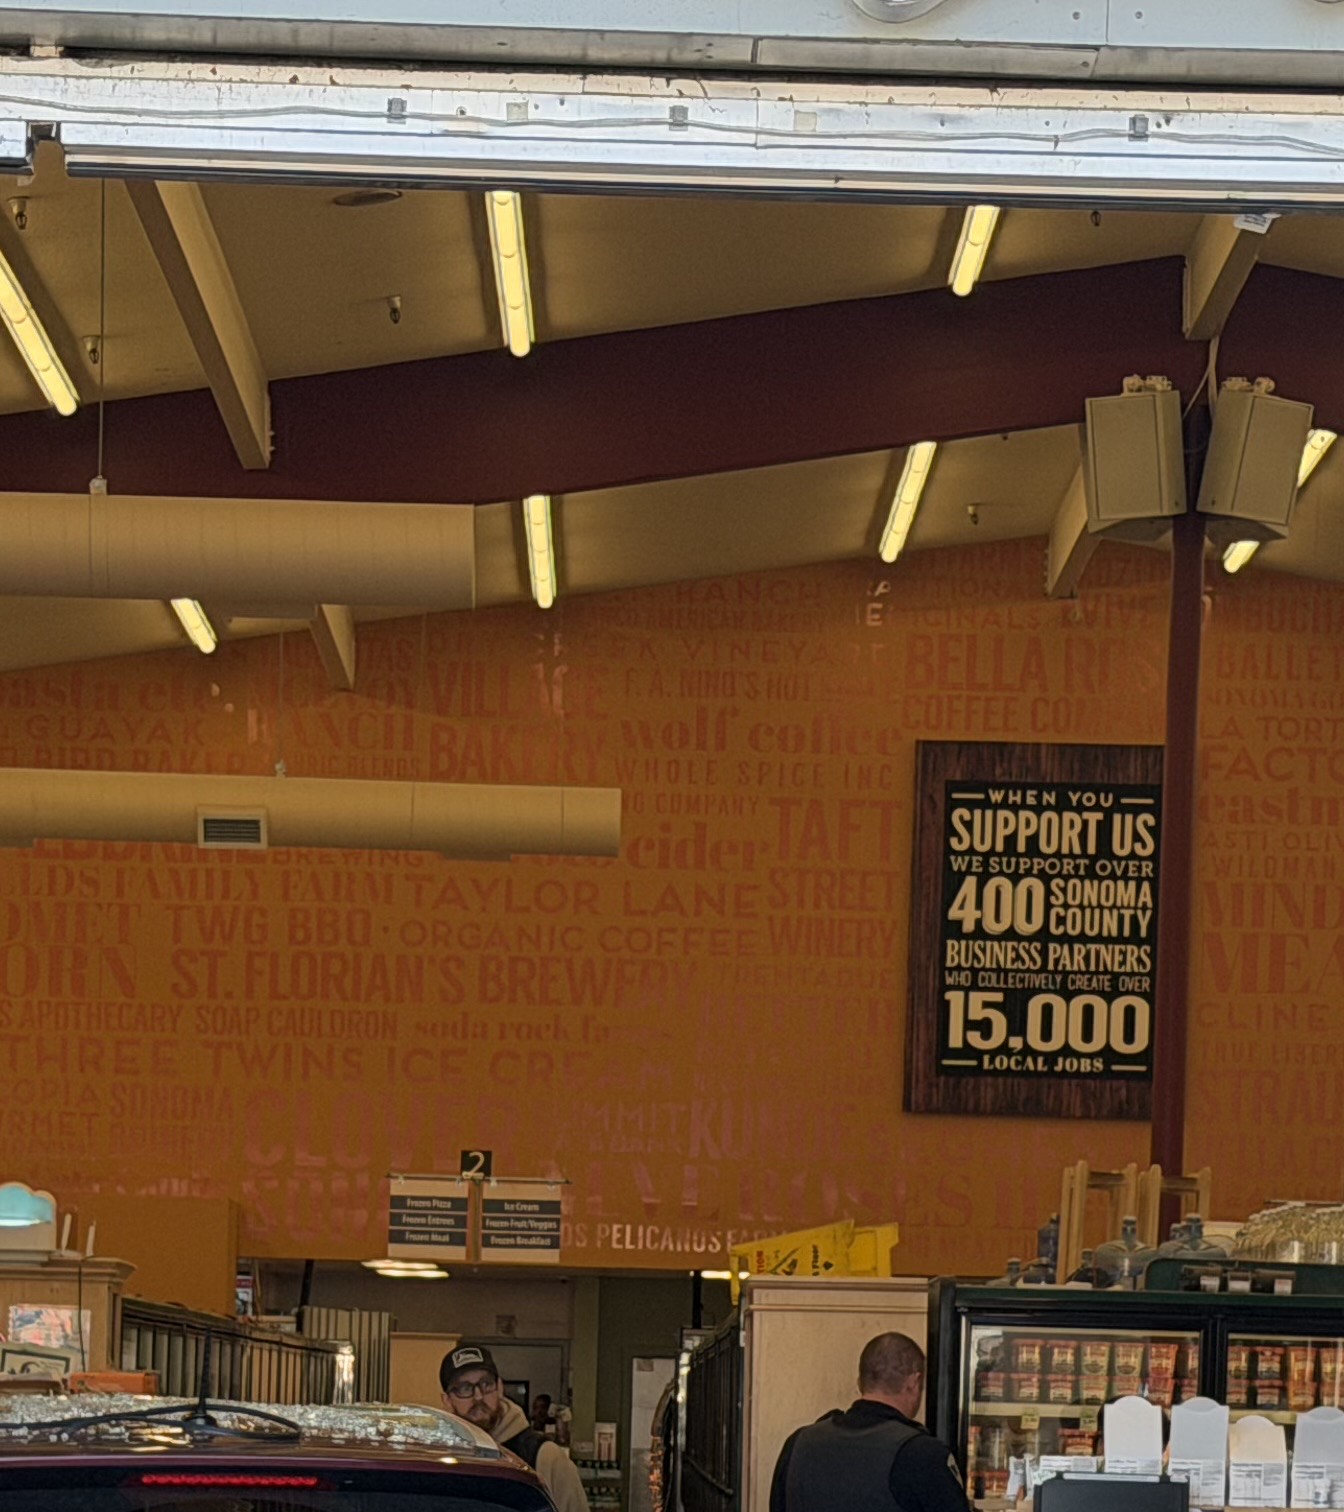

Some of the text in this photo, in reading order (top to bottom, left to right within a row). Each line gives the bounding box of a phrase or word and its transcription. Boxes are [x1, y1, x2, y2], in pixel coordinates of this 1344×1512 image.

[989, 788, 1114, 807] WHEN YOU
[949, 807, 1156, 857] SUPPORT US
[949, 855, 1154, 878] WE SUPPORT OVER
[408, 874, 762, 919] TAYLOR LANE
[1049, 878, 1154, 909] SONOMA
[947, 875, 1045, 936] 400
[1048, 907, 1154, 938] COUNTY
[945, 939, 1152, 974] BUSINESS PARTNERS
[944, 970, 1151, 993] WHO COLLECTIVELY CREATE OVER
[944, 990, 1151, 1056] 15,000
[202, 1040, 366, 1084] TWINS
[385, 1046, 469, 1086] ICE
[982, 1054, 1105, 1074] LOCAL JOBS
[462, 1150, 486, 1179] 2
[406, 1198, 452, 1209] Frozen Pizza
[516, 1203, 540, 1212] Cream
[402, 1214, 426, 1224] Frozen
[485, 1218, 509, 1228] Frozen
[405, 1231, 430, 1241] Frozen
[490, 1235, 515, 1246] Frozen
